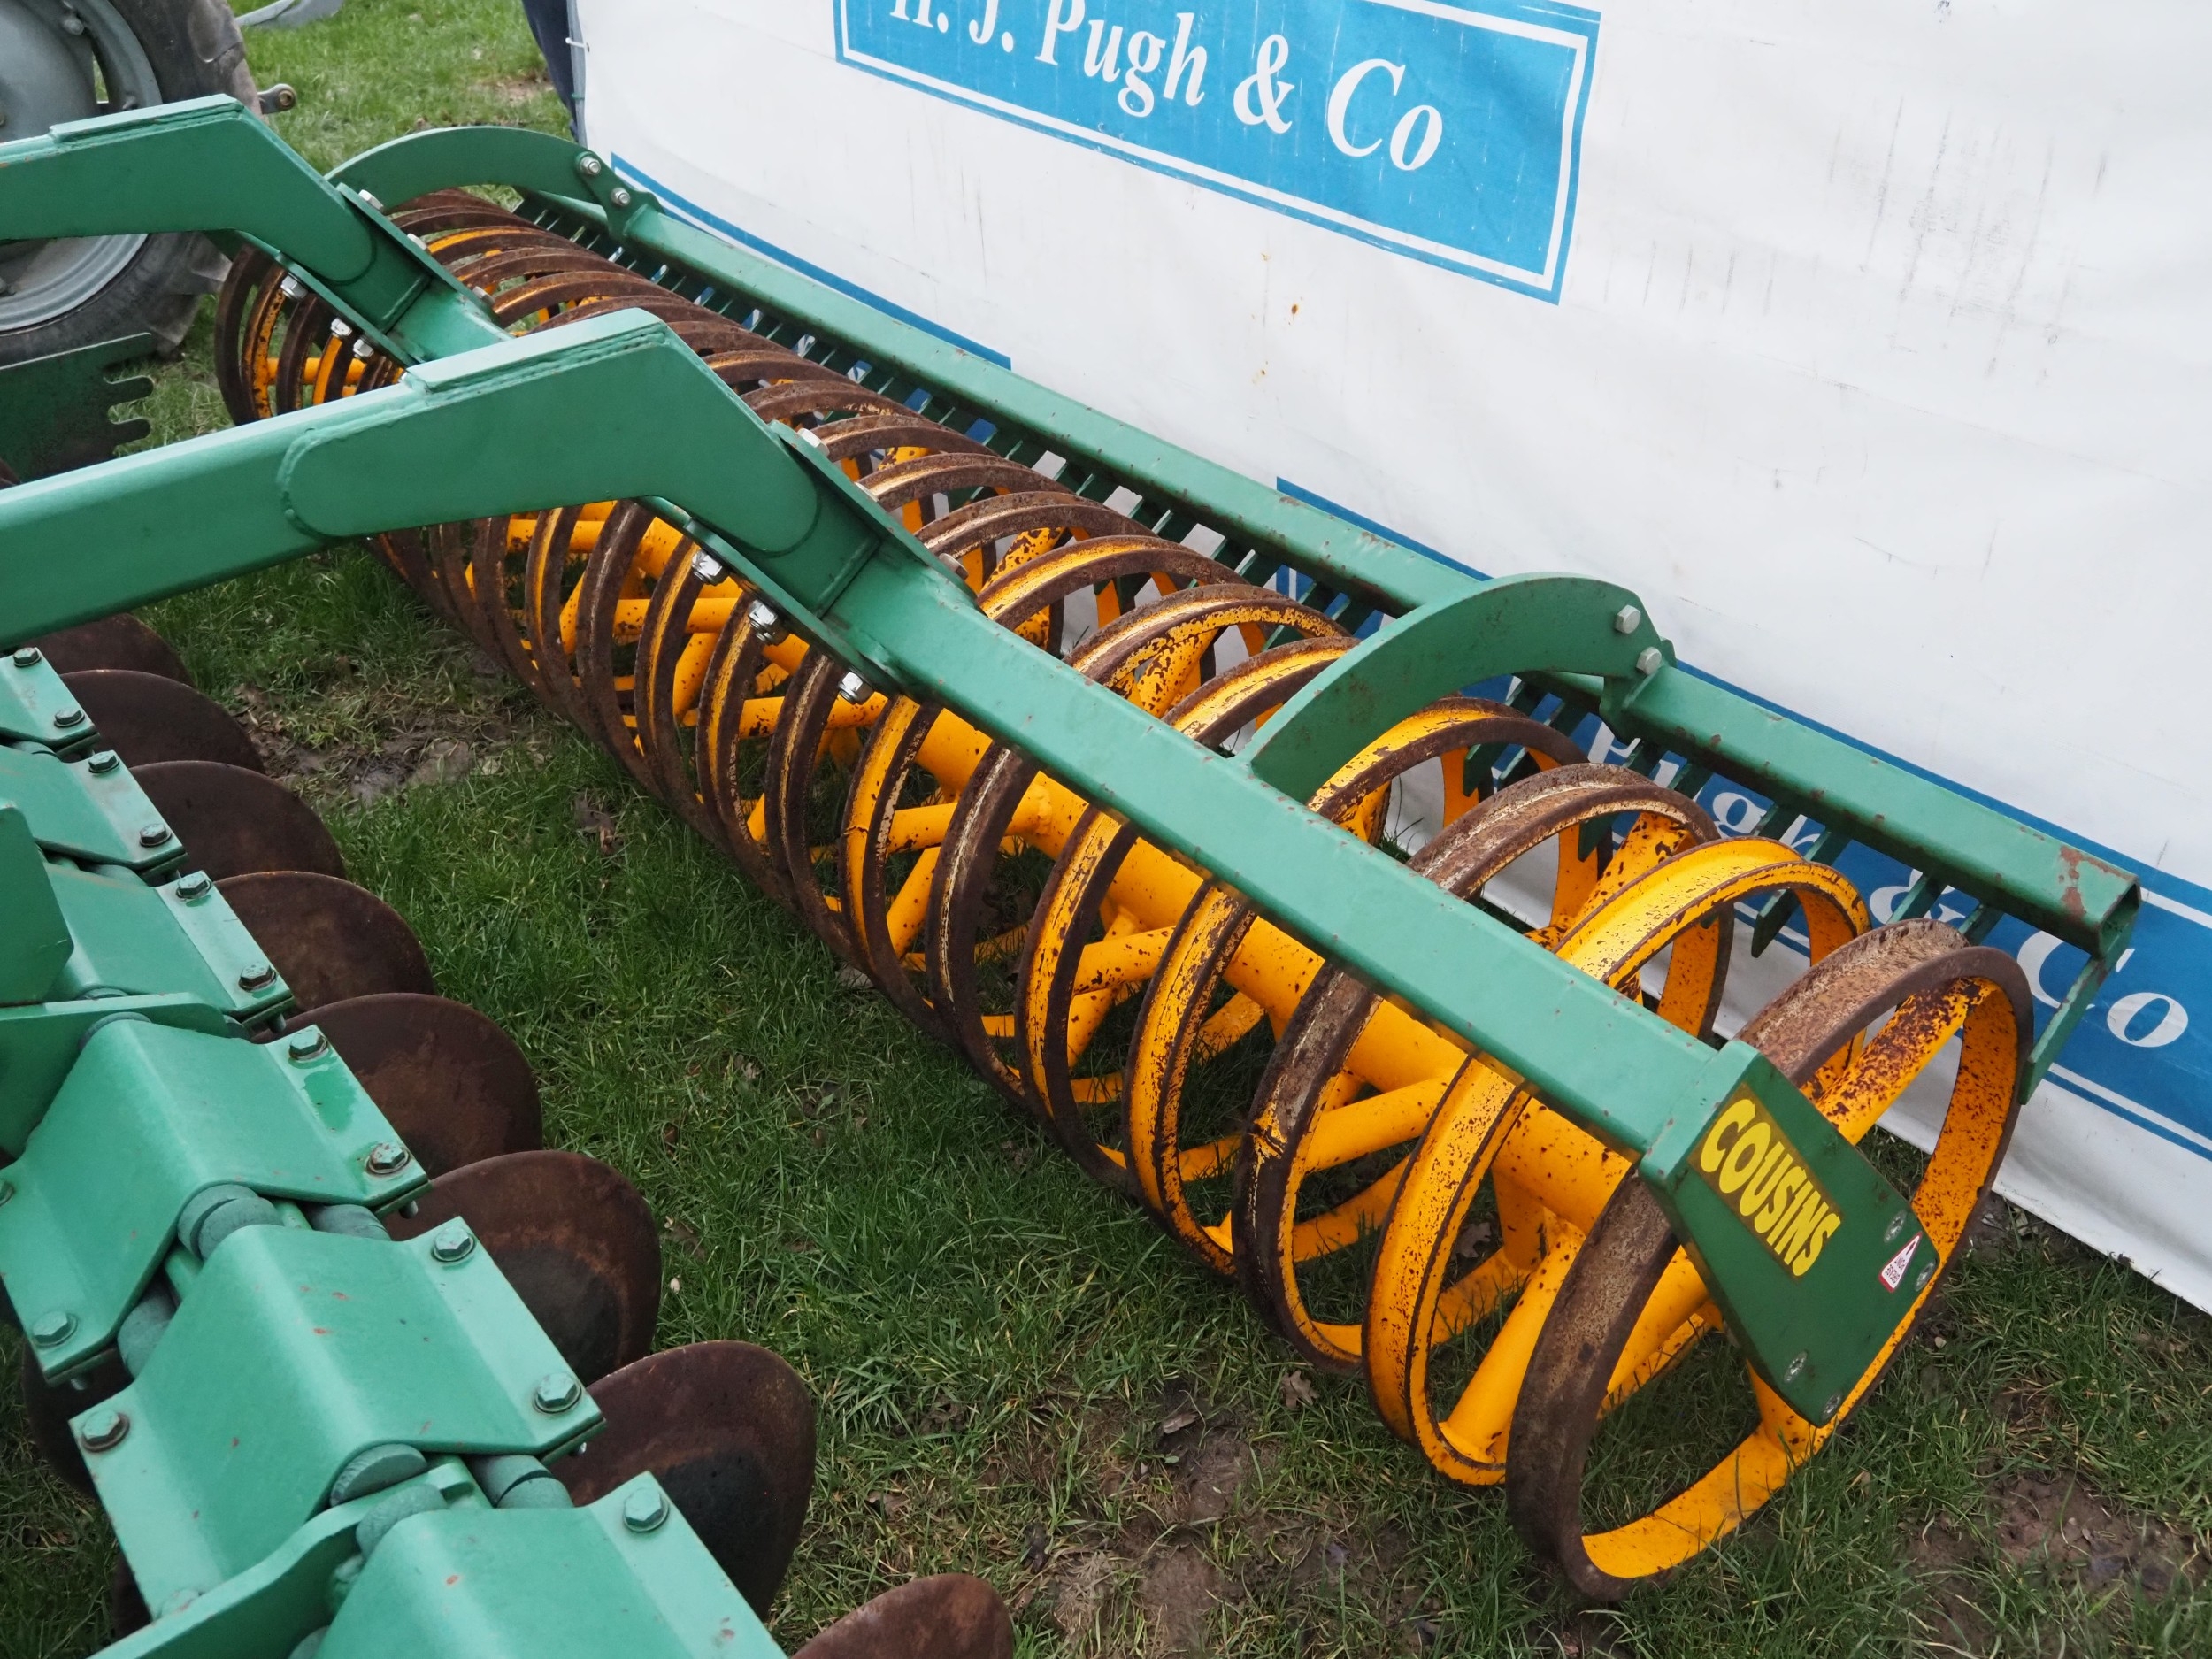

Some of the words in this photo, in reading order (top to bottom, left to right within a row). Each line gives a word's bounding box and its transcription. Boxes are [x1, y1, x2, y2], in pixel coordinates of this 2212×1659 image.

[1034, 0, 1205, 118] Pugh
[1233, 34, 1294, 134] &
[1326, 58, 1444, 172] Co
[1700, 1098, 1841, 1277] COUSINS
